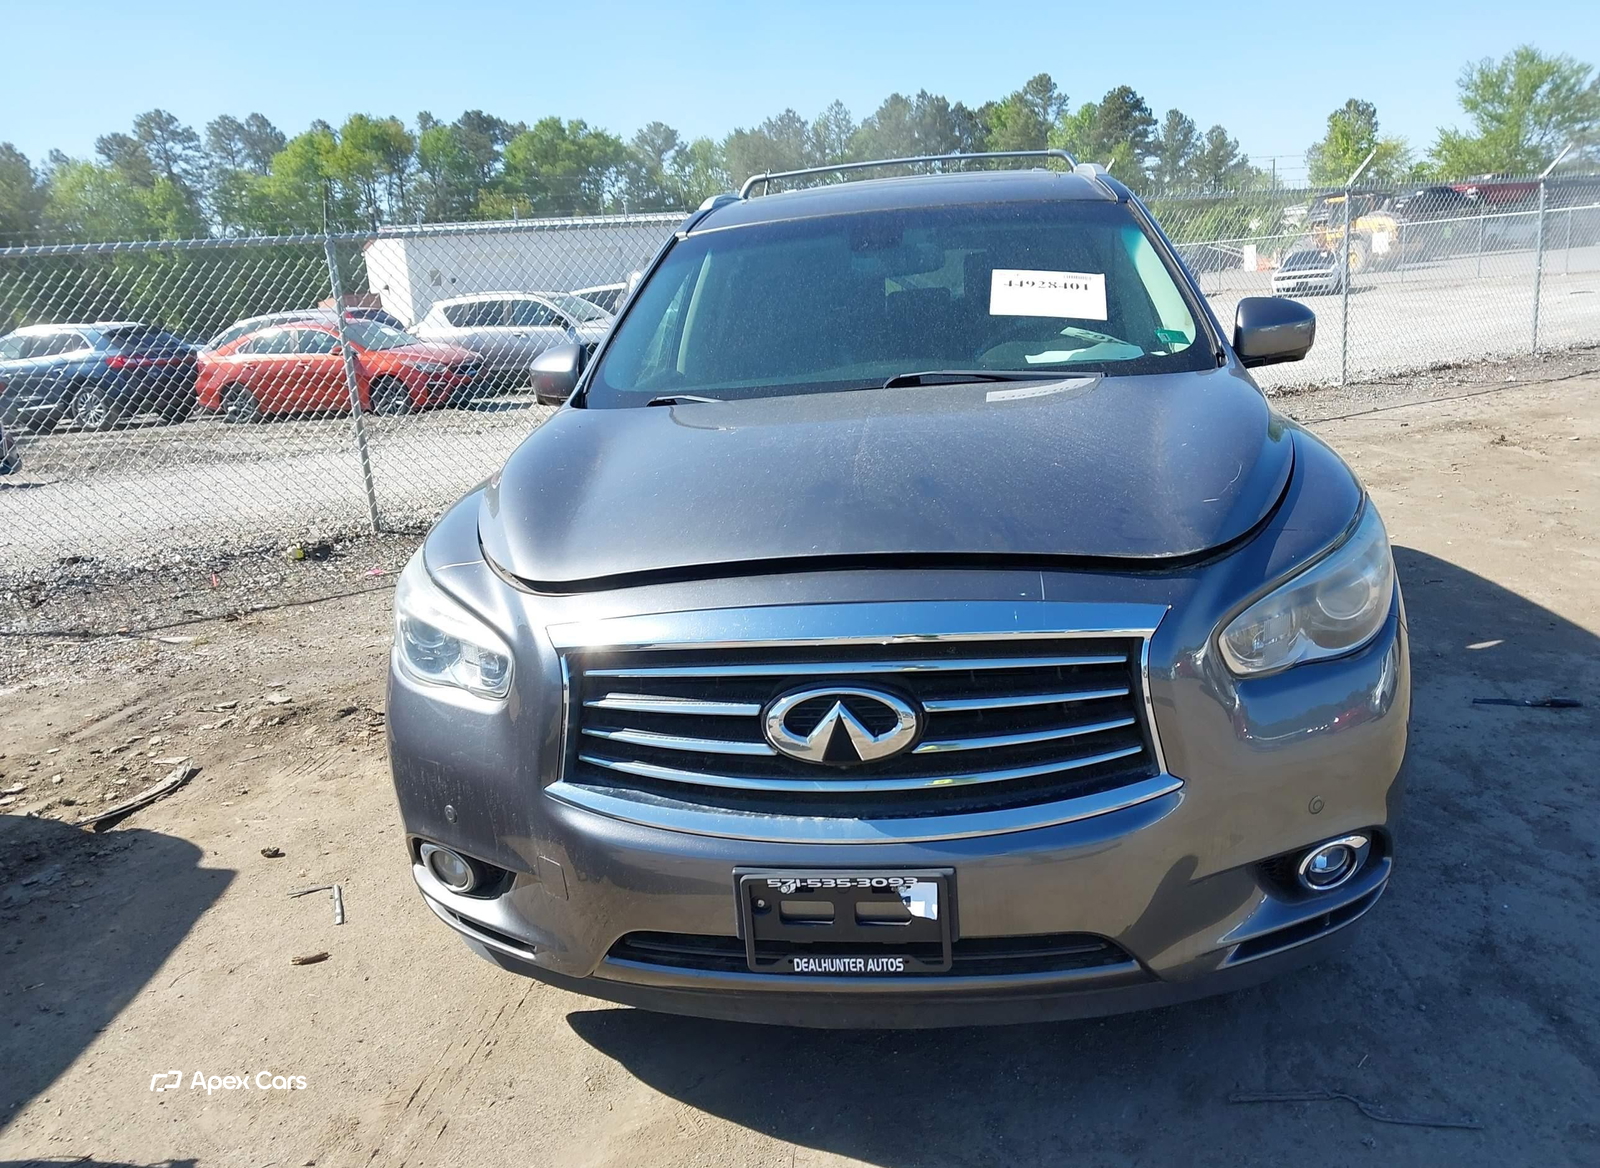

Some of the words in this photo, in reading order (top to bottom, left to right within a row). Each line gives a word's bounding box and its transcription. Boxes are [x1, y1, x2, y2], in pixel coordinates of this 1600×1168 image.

[1003, 279, 1089, 291] 44928401
[766, 876, 918, 888] 571-535-3093
[793, 958, 865, 972] DEALHUNTER
[866, 957, 904, 972] AUTOS
